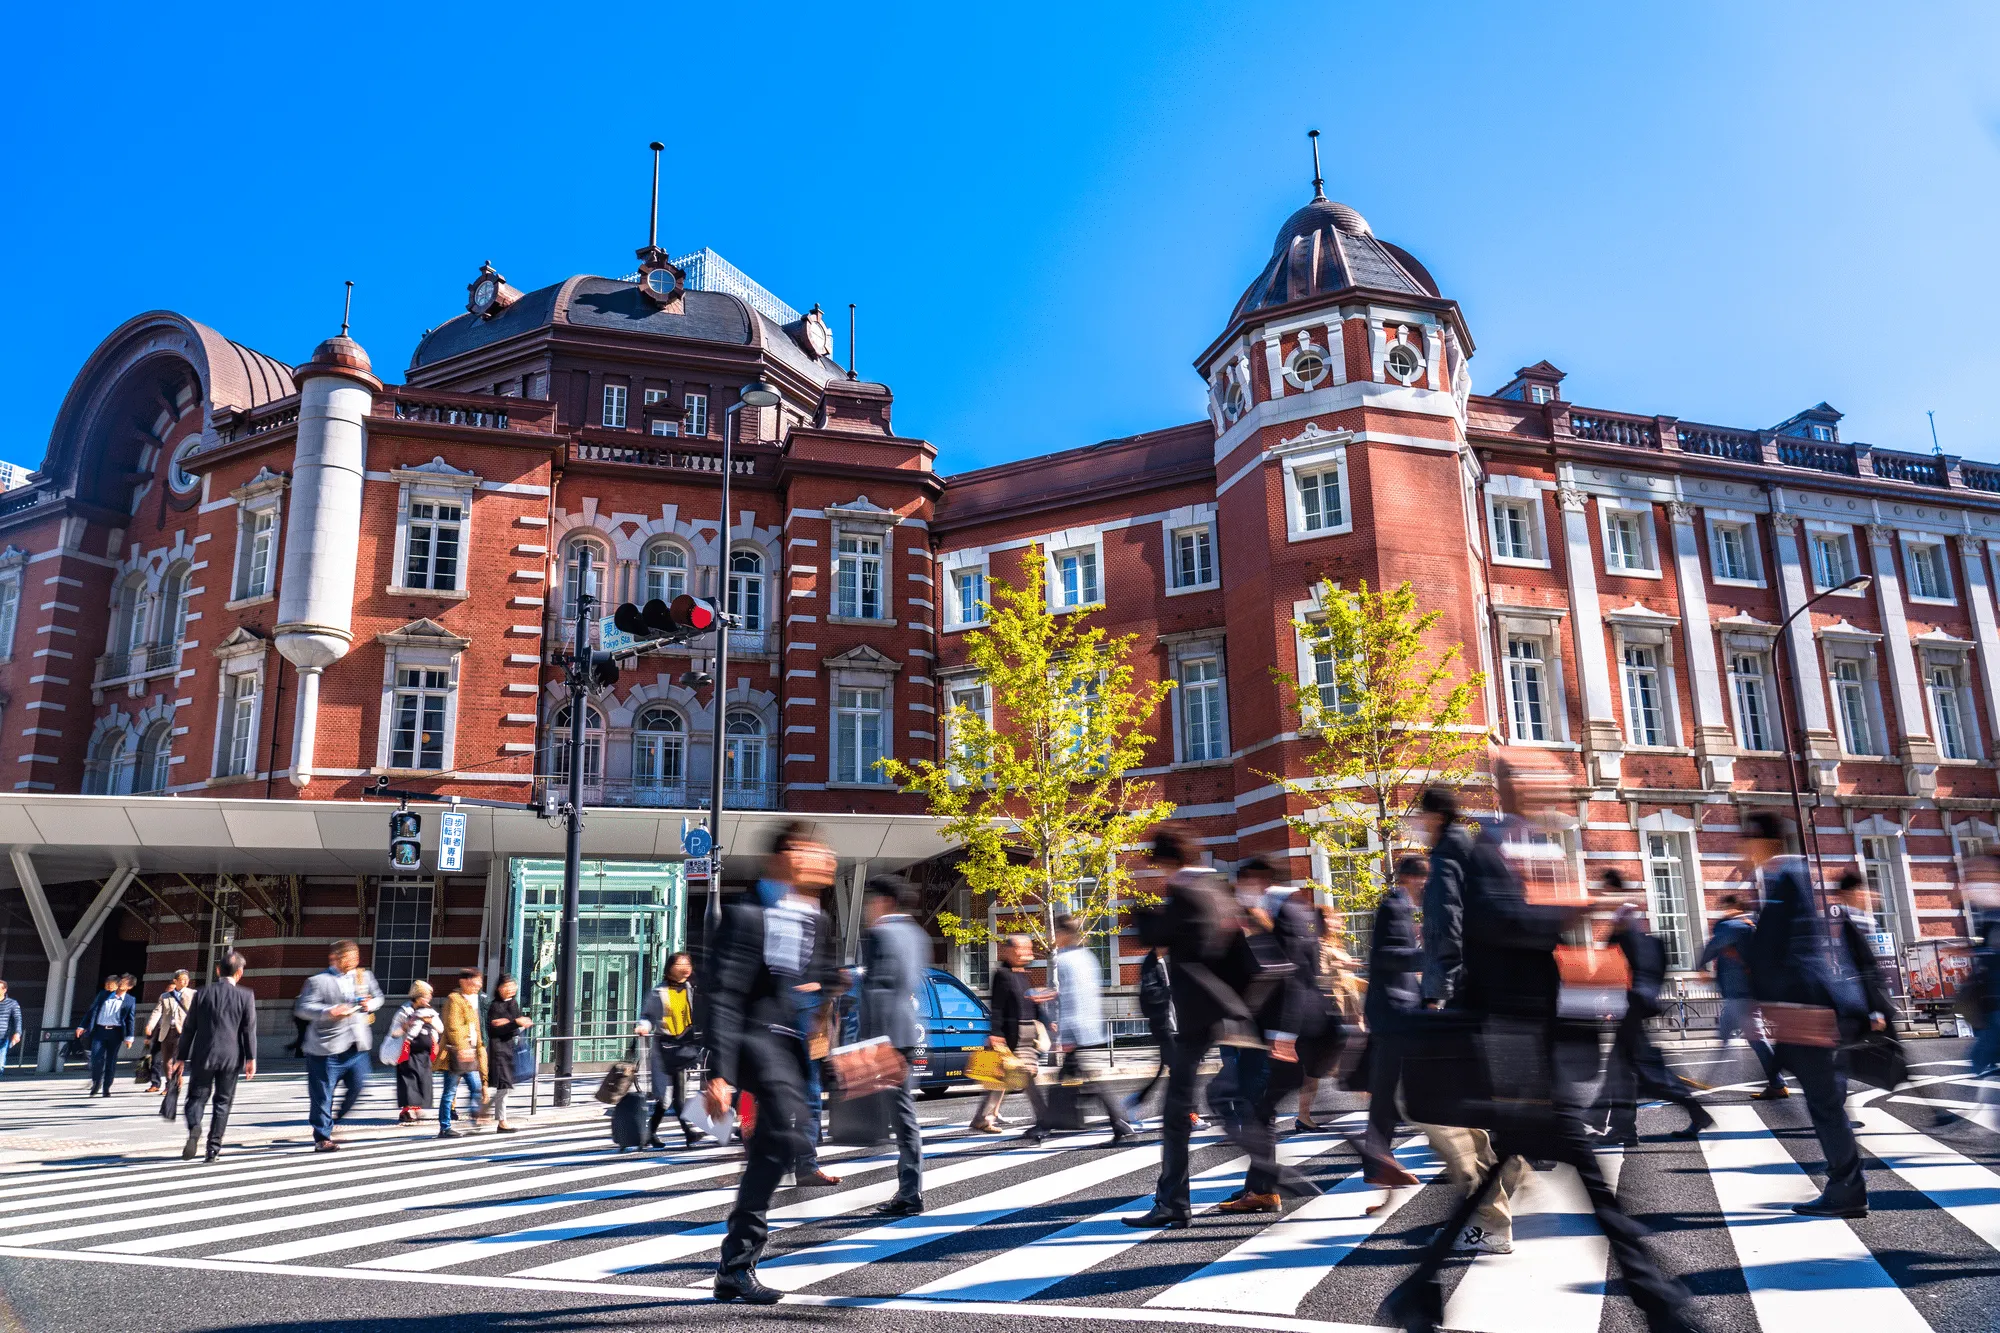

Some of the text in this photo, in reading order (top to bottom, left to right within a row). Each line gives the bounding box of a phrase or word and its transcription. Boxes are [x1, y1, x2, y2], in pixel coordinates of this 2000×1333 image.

[603, 640, 618, 650] Tokyo
[444, 817, 453, 845] 自転車
[453, 818, 462, 847] 歩行者
[690, 836, 701, 854] P
[446, 847, 456, 866] 専用
